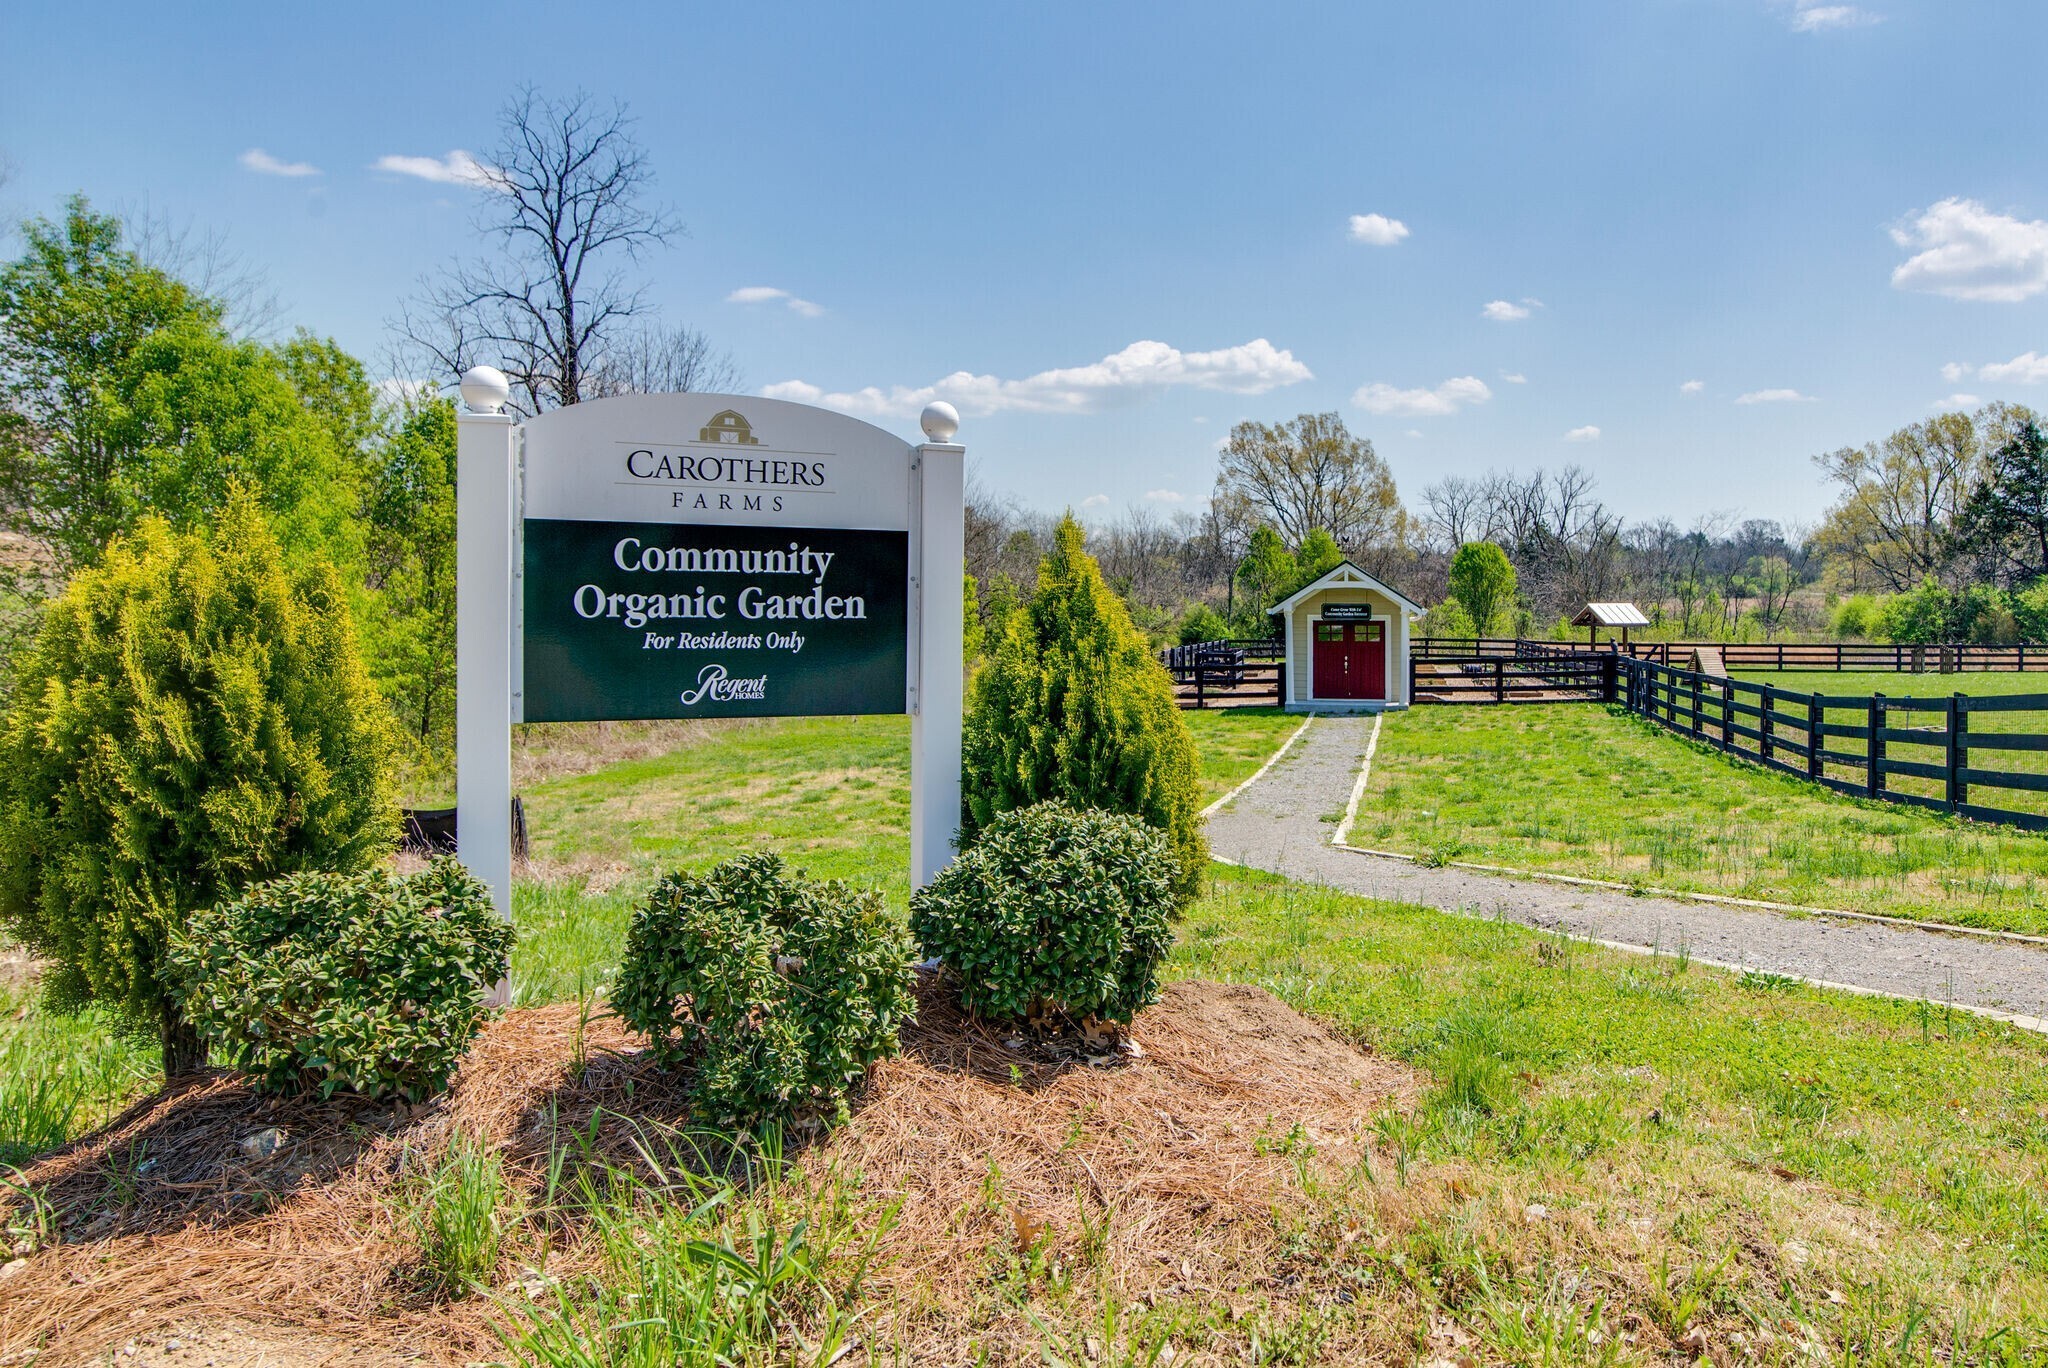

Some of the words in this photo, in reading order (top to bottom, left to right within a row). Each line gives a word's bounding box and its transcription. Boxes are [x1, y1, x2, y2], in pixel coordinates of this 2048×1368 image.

[627, 450, 825, 487] CAROTHERS
[672, 492, 783, 512] FARMS
[613, 537, 835, 583] Community
[573, 584, 726, 628] Organic
[738, 586, 867, 619] Garden
[642, 632, 675, 650] For
[677, 631, 762, 650] Residents
[766, 631, 805, 653] Only
[681, 664, 768, 706] Regent
[735, 692, 765, 700] HOMES
